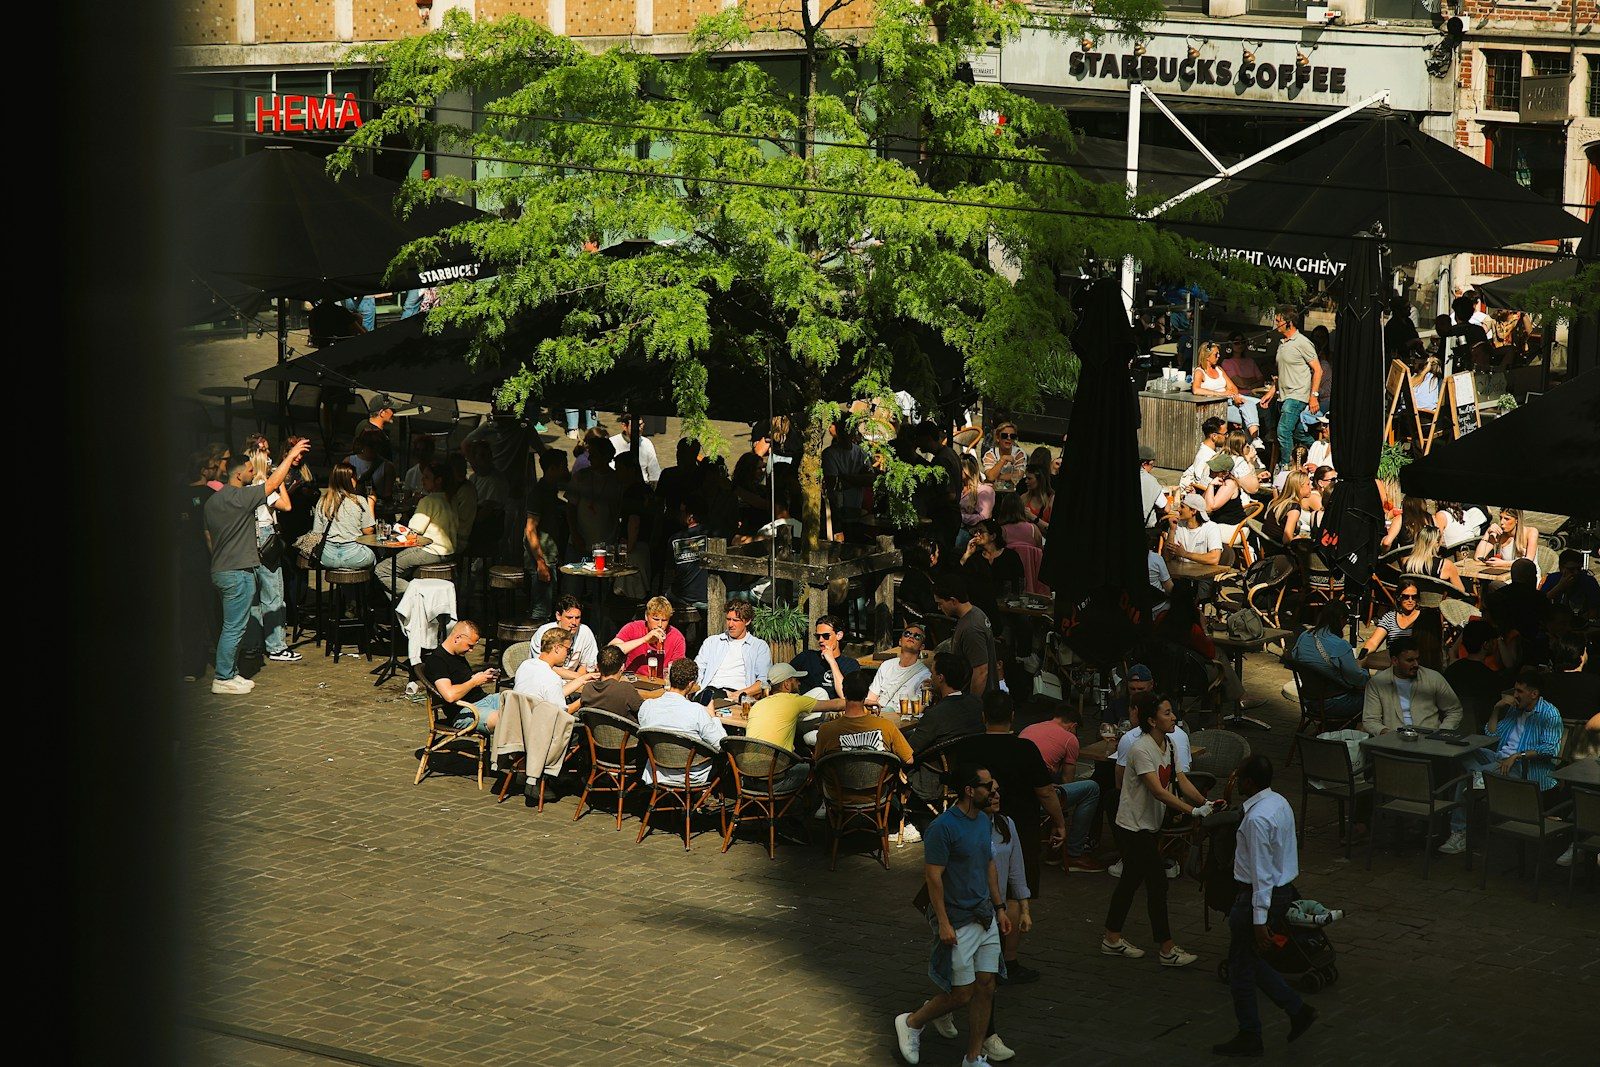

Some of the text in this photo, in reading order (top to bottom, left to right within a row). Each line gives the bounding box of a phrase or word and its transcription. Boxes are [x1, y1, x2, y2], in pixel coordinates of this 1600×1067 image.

[1069, 51, 1347, 94] STARBUCKS COFFEE
[255, 93, 363, 133] HEMA
[1267, 255, 1293, 270] VAN
[1295, 257, 1347, 276] GHENT
